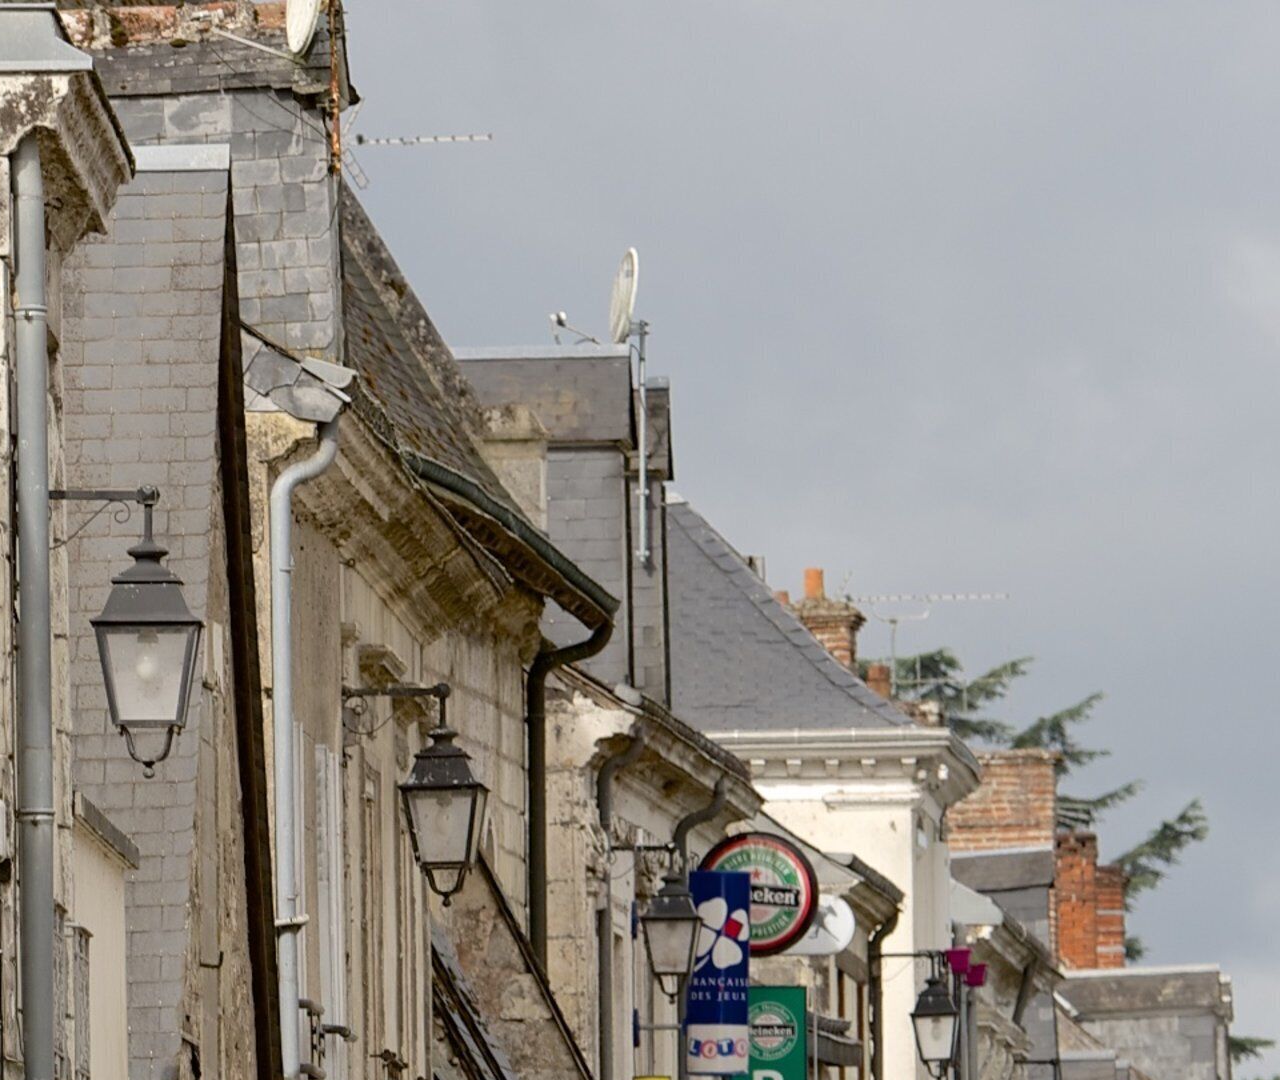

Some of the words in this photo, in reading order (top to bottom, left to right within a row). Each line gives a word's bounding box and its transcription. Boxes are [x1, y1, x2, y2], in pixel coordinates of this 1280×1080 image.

[691, 991, 712, 1001] DES
[716, 991, 746, 1002] JEUX
[689, 1038, 747, 1060] LOTO
